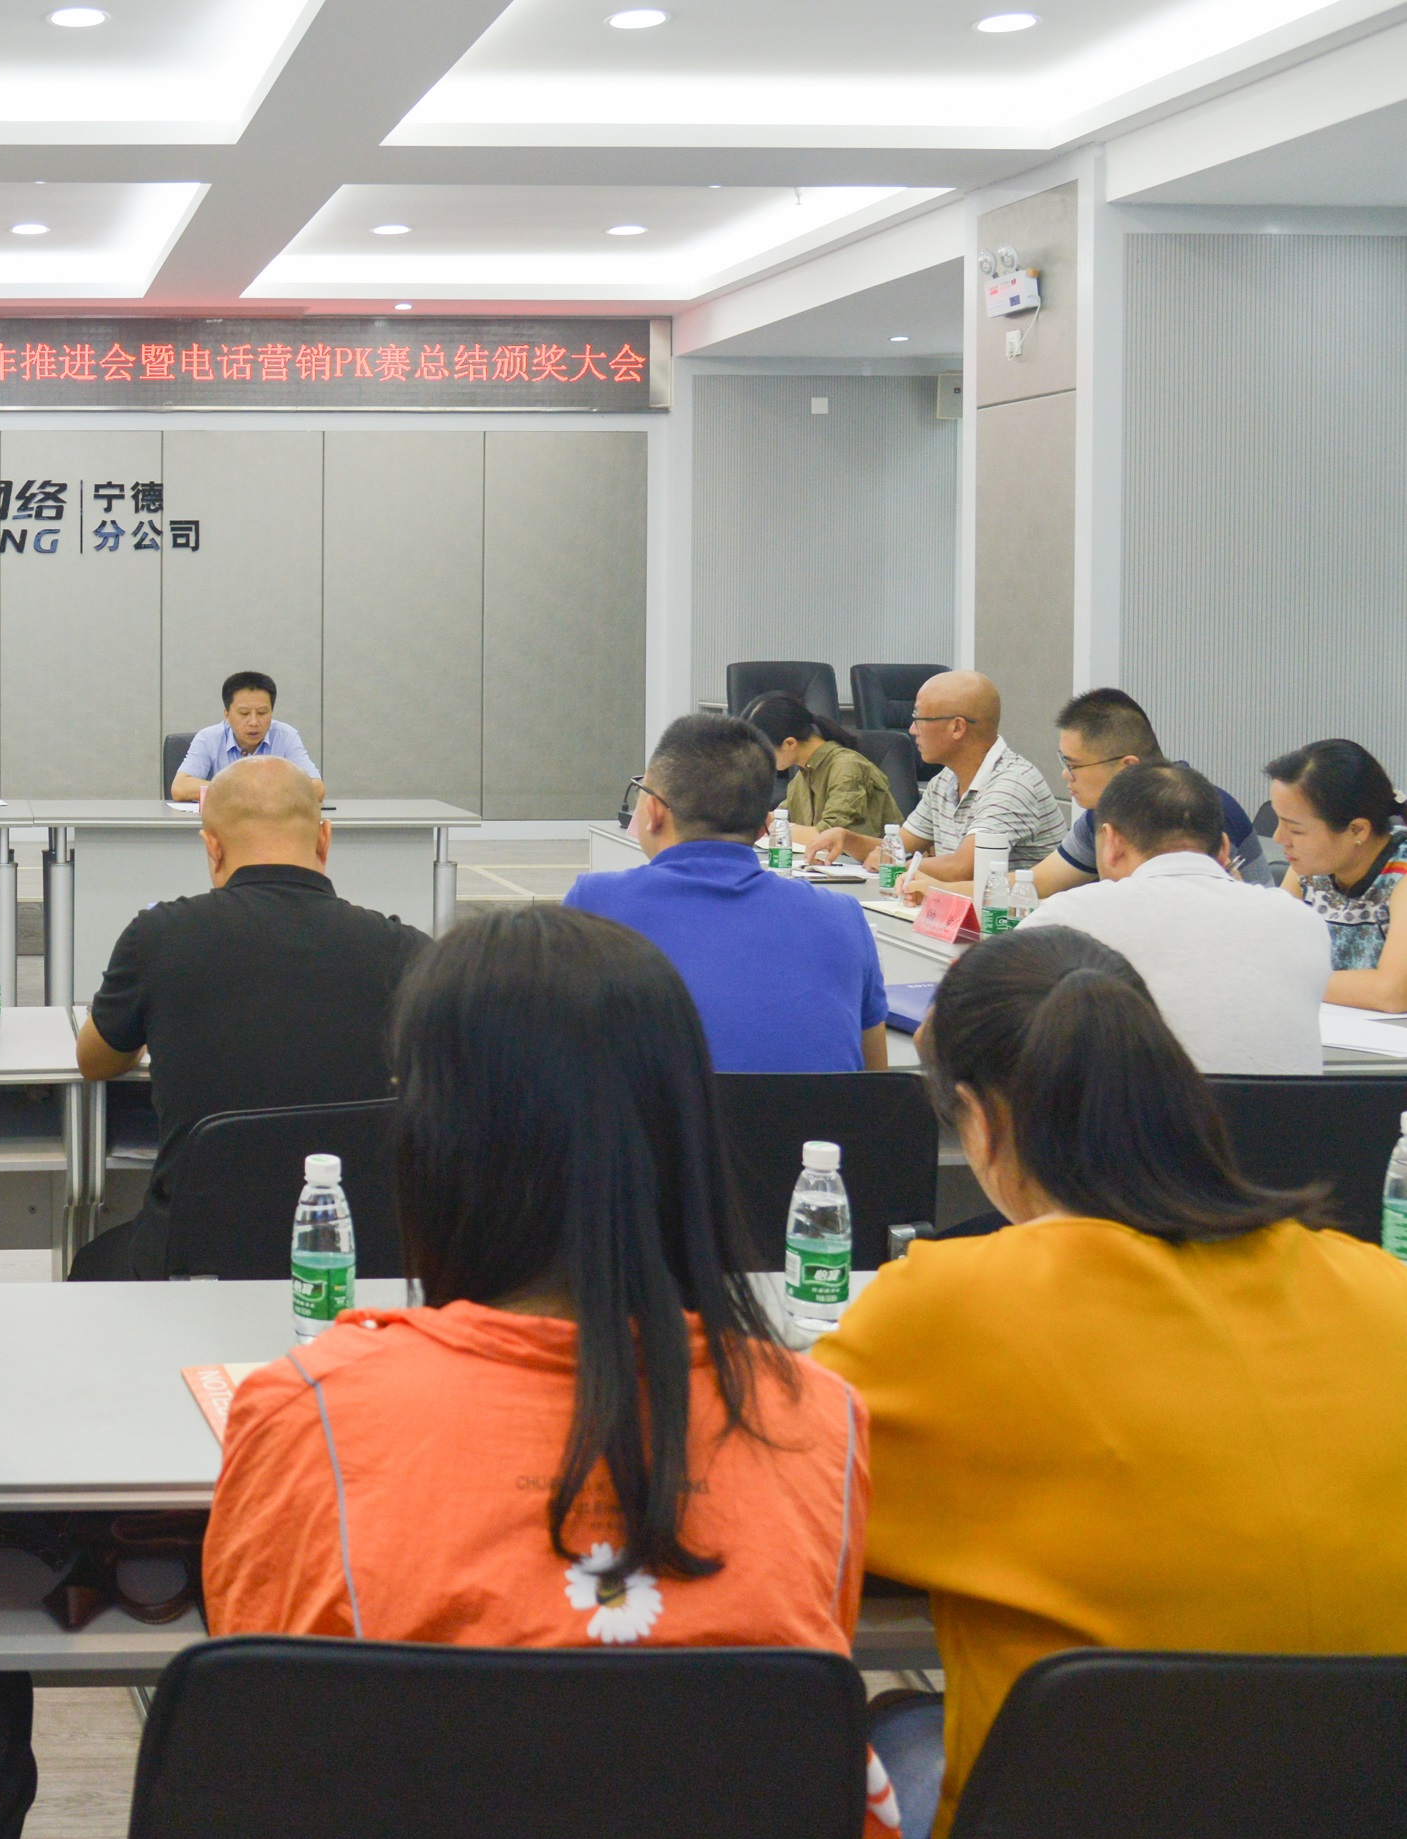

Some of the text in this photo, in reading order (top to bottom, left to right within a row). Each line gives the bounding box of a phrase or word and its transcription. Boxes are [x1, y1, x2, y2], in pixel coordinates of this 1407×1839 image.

[92, 479, 164, 515] 宁德
[92, 519, 201, 552] 分公司
